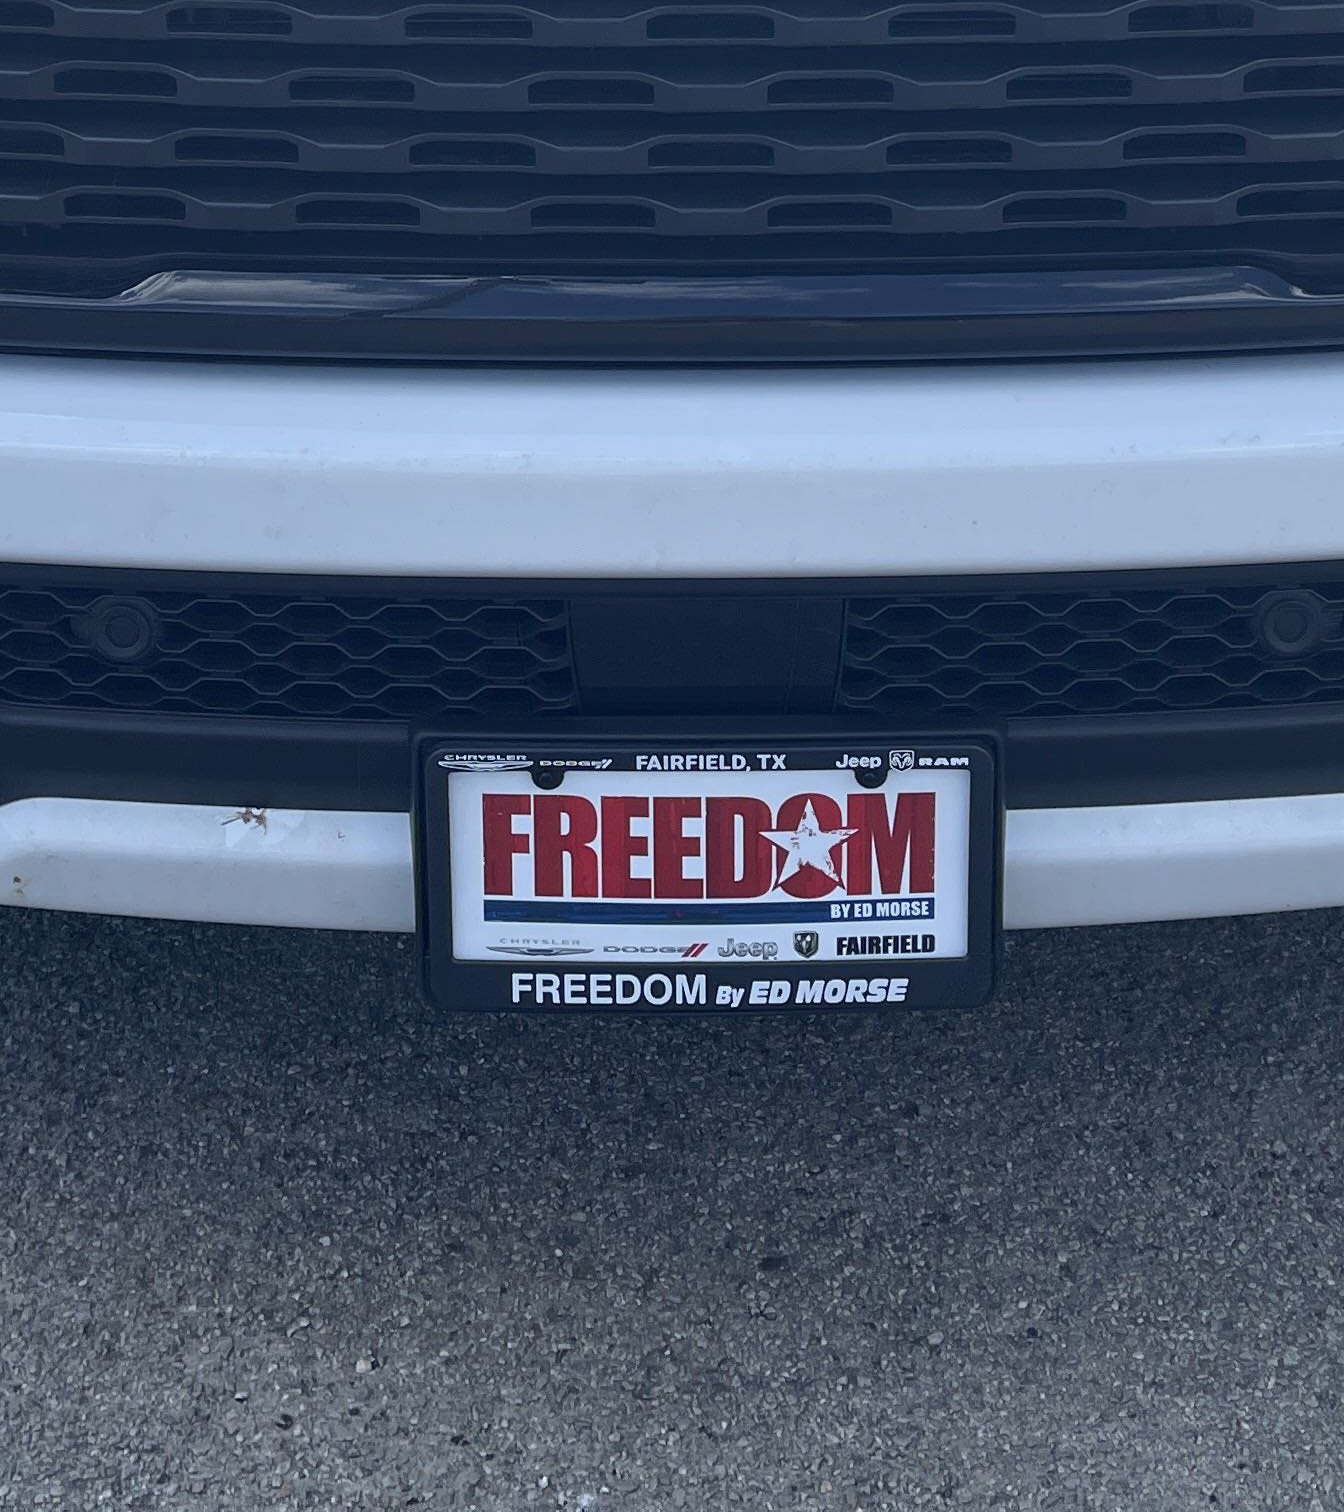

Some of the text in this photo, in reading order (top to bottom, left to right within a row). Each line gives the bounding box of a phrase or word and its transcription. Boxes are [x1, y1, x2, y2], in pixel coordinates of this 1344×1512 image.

[636, 754, 787, 772] FAIRFIELD, TX
[835, 754, 882, 769] Jeep
[918, 757, 969, 766] RAM
[482, 792, 935, 898] FREEDOM
[830, 901, 929, 919] BY ED MORSE
[499, 938, 581, 946] CHRYSLER
[717, 938, 778, 960] Jeep
[836, 934, 935, 956] FAIRFIELD
[511, 973, 909, 1008] FREEDOM By ED MORSE
